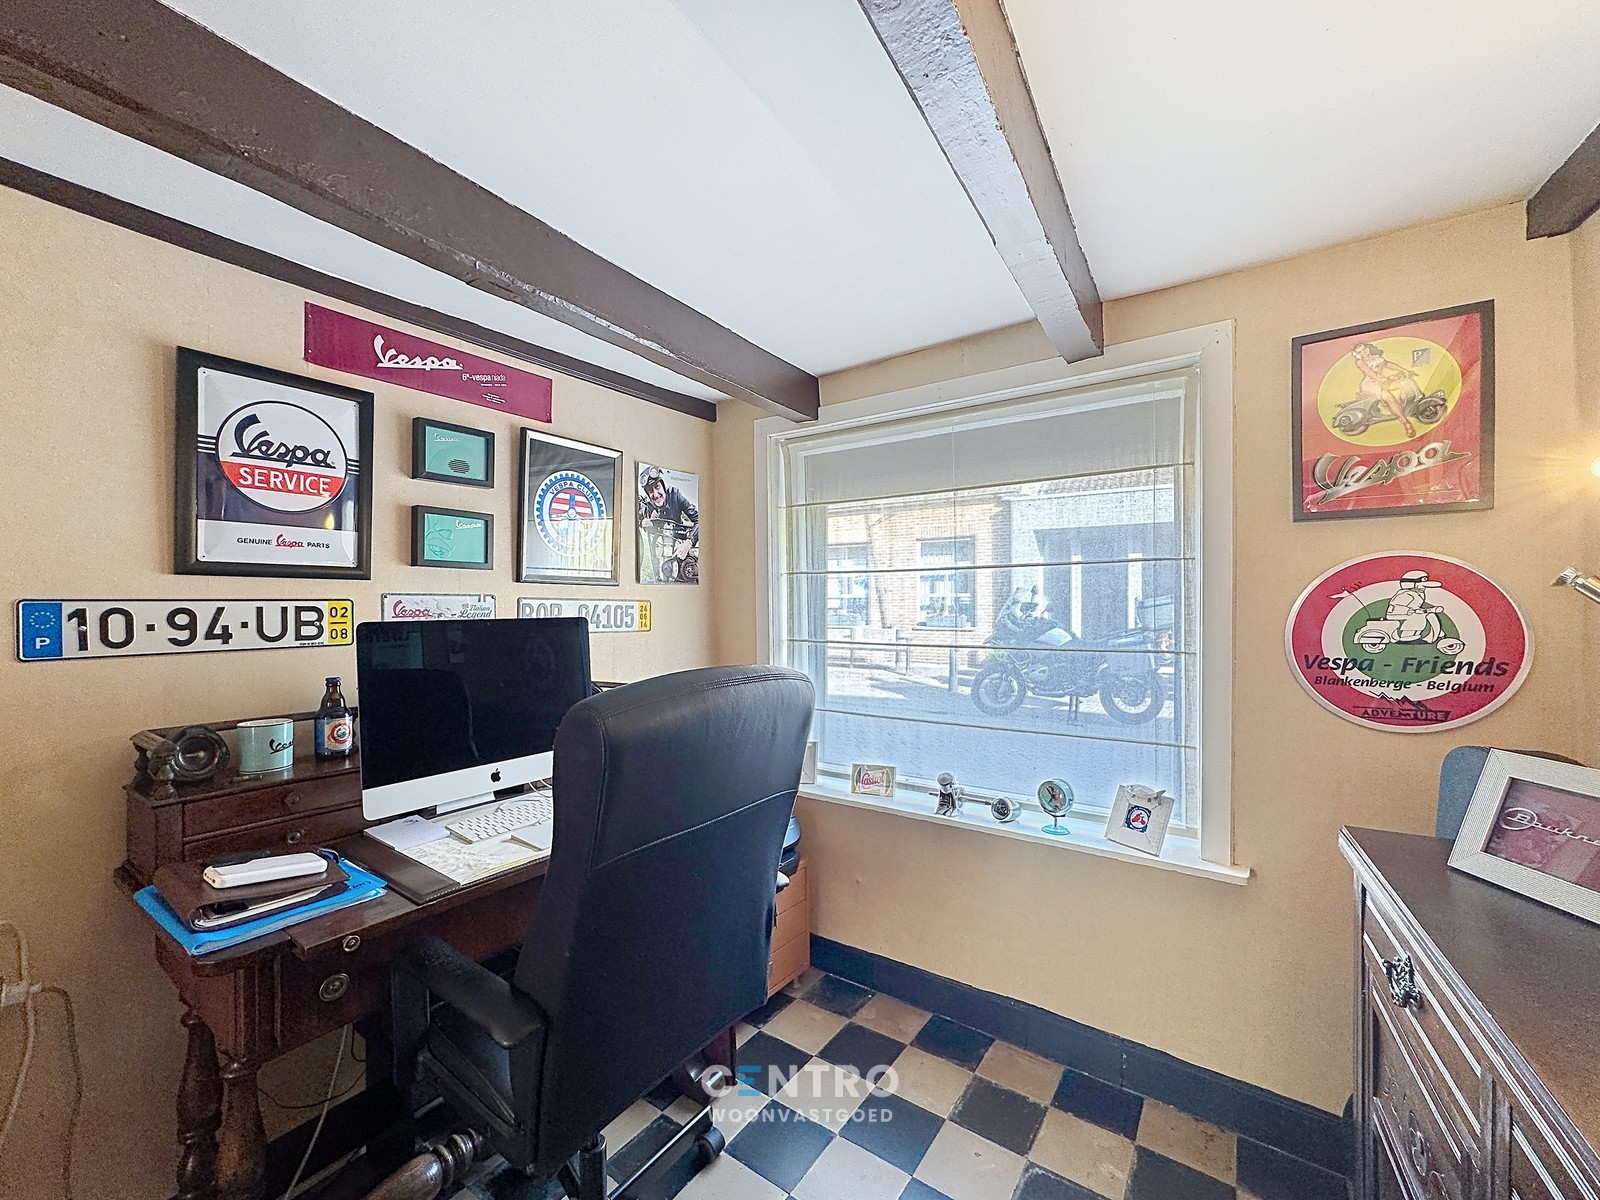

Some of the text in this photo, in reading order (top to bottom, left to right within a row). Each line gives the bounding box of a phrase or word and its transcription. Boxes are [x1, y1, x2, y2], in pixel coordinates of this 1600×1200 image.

[374, 334, 463, 371] Vespa
[229, 413, 336, 469] Vespa
[238, 467, 332, 497] SERVICE
[1312, 439, 1472, 506] Vespa
[549, 481, 594, 502] VESPA CLUB
[237, 534, 330, 549] GENUINE Vespa PARTS
[330, 606, 349, 618] 02
[392, 599, 433, 619] Vespa
[458, 609, 492, 619] Legend
[35, 637, 50, 650] P
[330, 628, 348, 640] 08
[1304, 654, 1374, 674] Vespa
[1401, 655, 1510, 677] Friends
[1314, 675, 1412, 691] Blankenberge
[1427, 679, 1495, 694] Belgium
[1362, 707, 1446, 722] ADVENTURE
